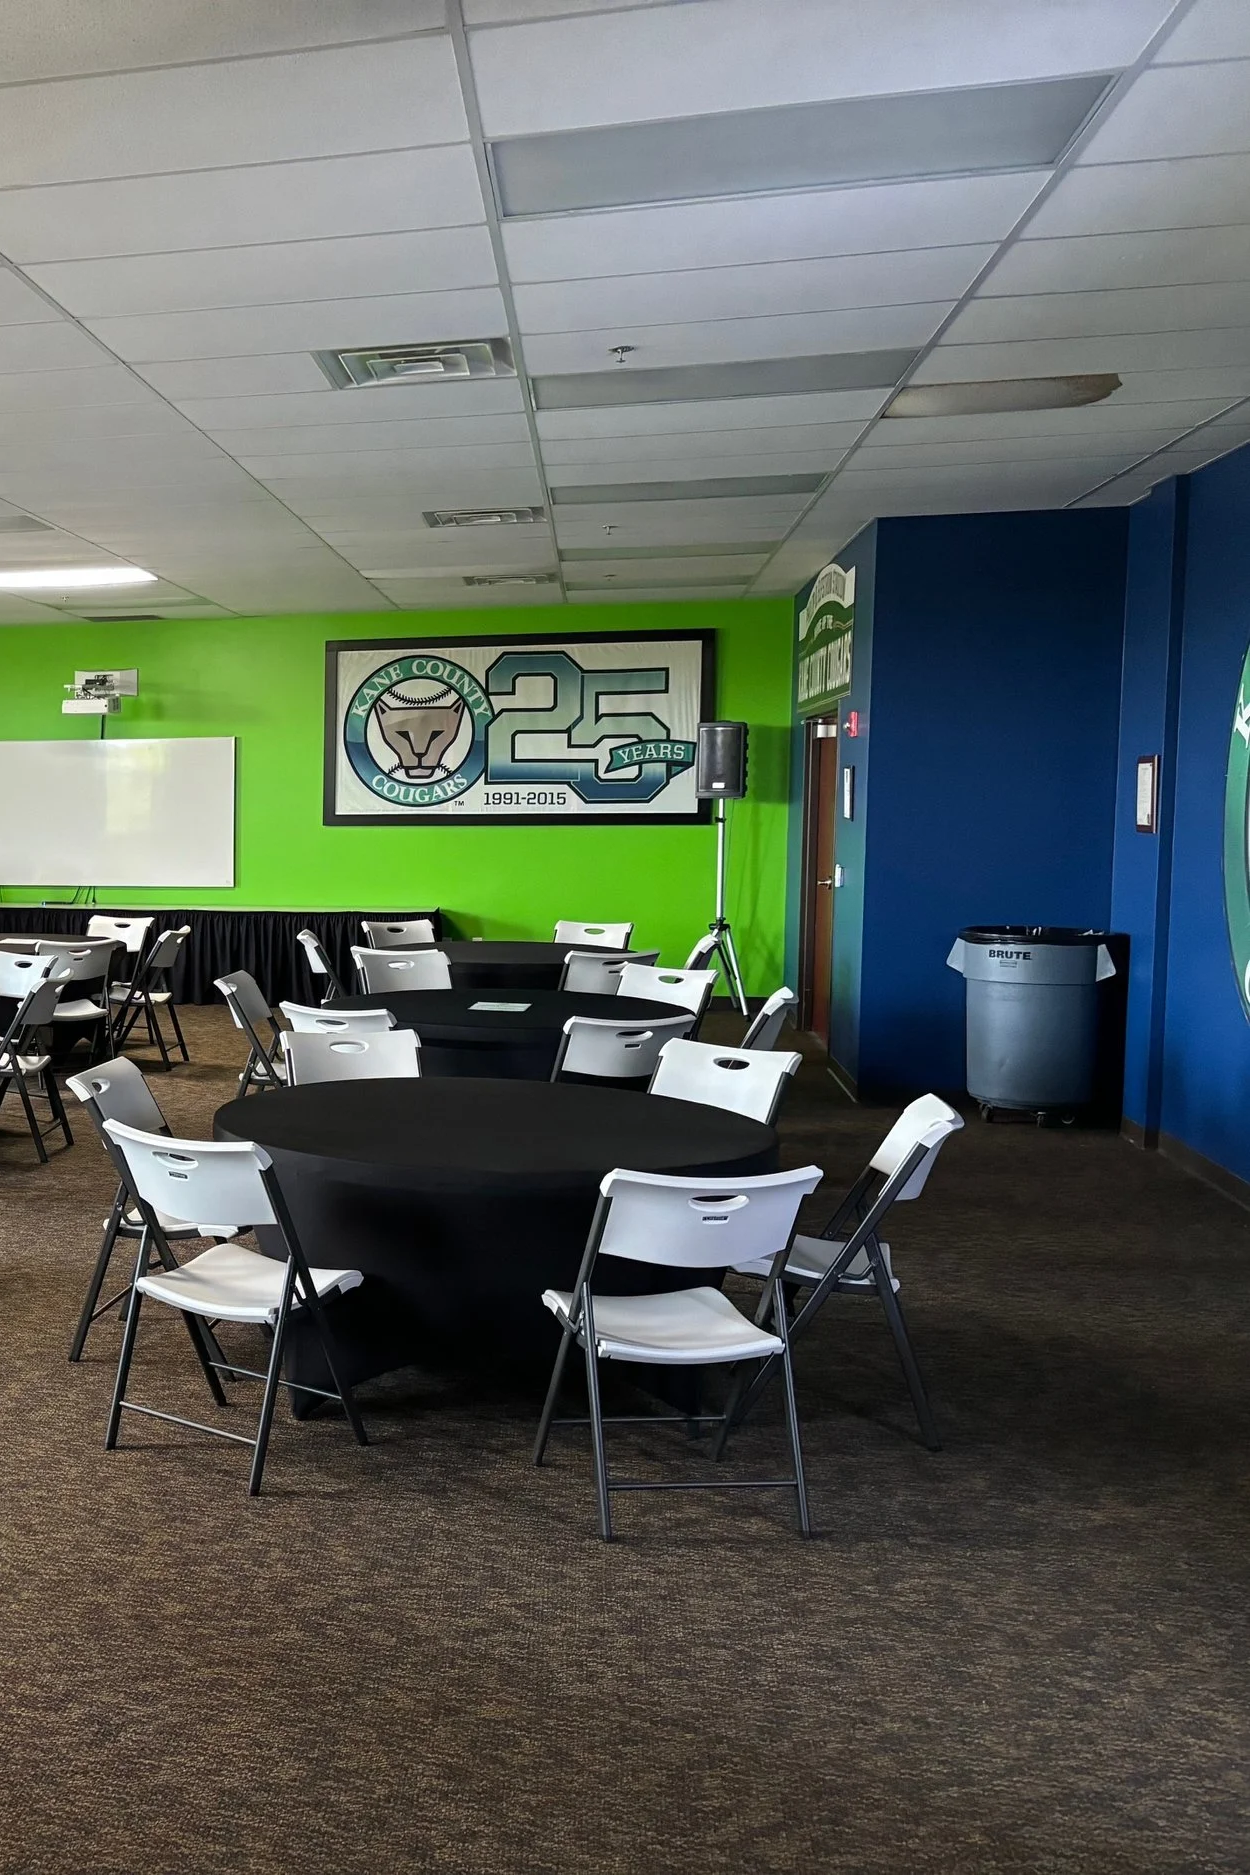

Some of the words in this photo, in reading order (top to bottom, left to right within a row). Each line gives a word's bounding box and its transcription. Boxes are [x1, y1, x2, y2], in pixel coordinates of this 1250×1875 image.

[352, 664, 403, 719] KANE
[411, 659, 493, 717] COUNTY
[484, 650, 670, 804] 25
[617, 742, 686, 764] YEARS
[371, 773, 468, 803] COUGARS
[483, 791, 567, 806] 1991-2015
[988, 949, 1032, 961] BRUTE
